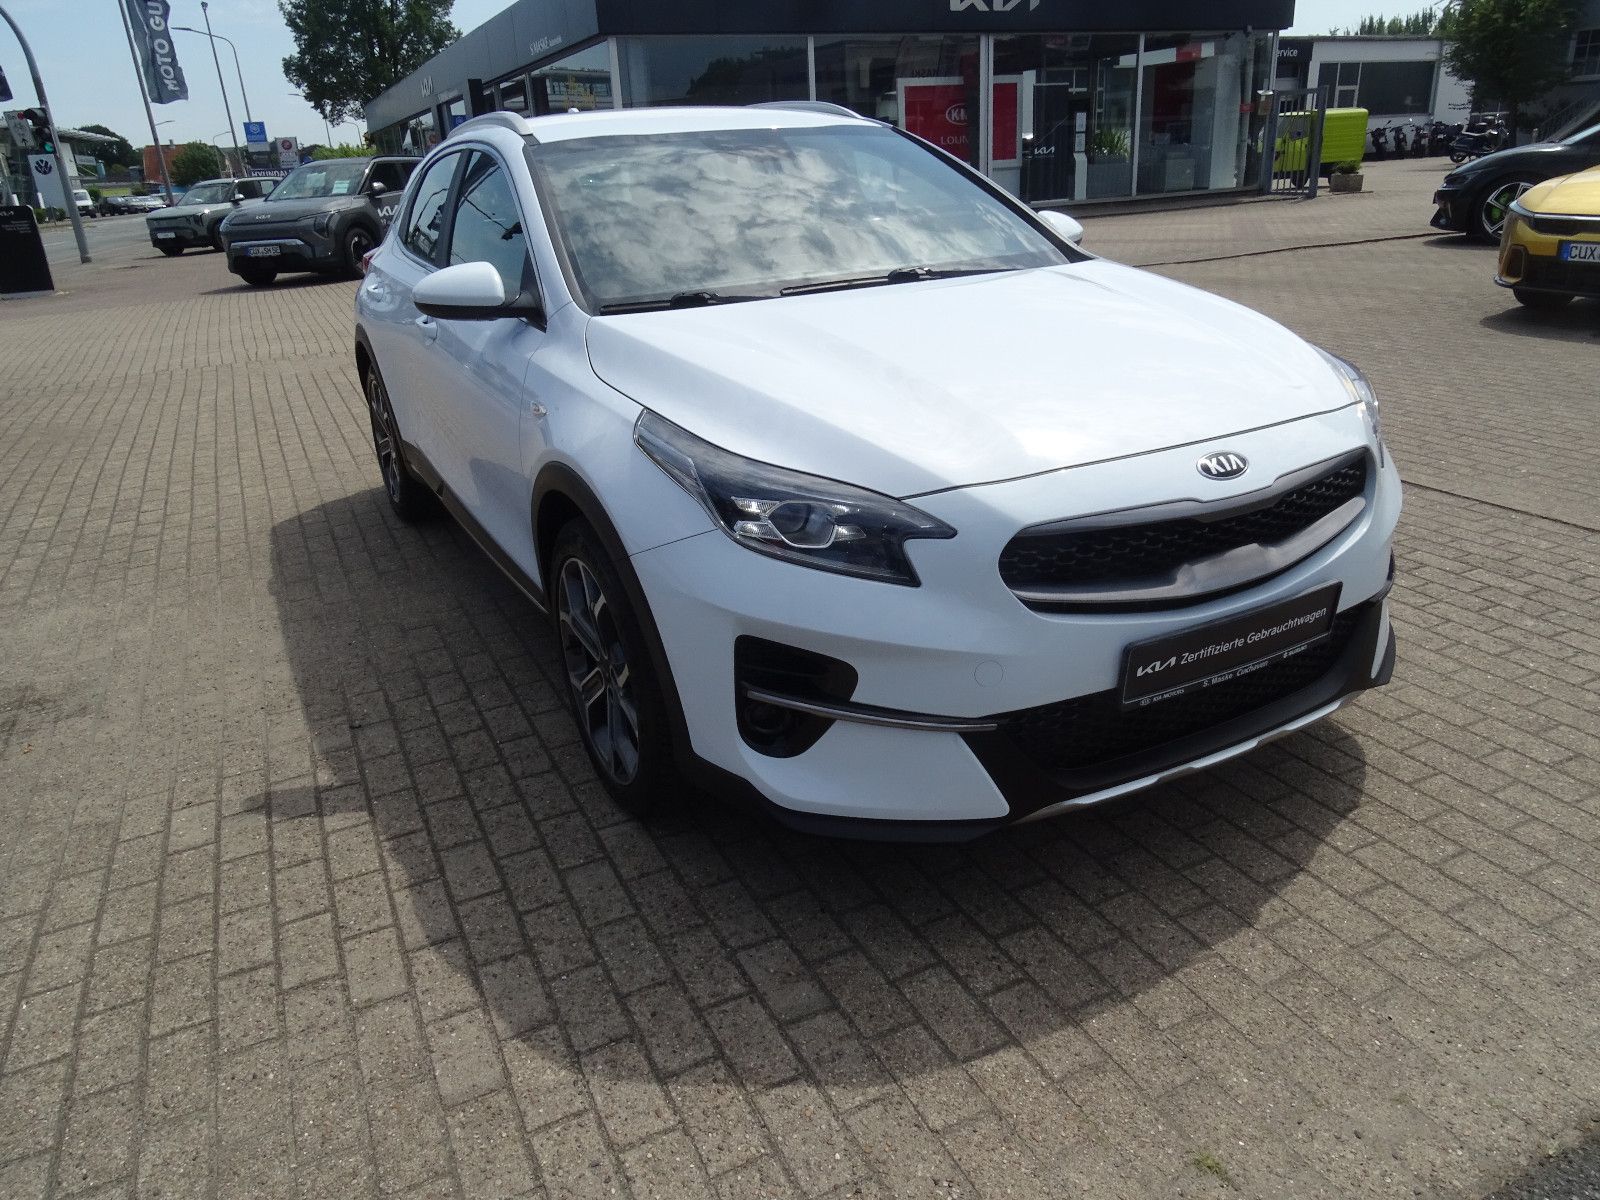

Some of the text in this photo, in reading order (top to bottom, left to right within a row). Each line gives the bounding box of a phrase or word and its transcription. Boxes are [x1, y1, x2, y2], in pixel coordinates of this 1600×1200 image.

[153, 38, 180, 91] MOTO
[950, 108, 968, 121] KI
[1569, 245, 1598, 260] CUX
[1207, 453, 1245, 475] KIA
[1136, 607, 1327, 677] KIA Zertifizierte Gebrauchtwagen
